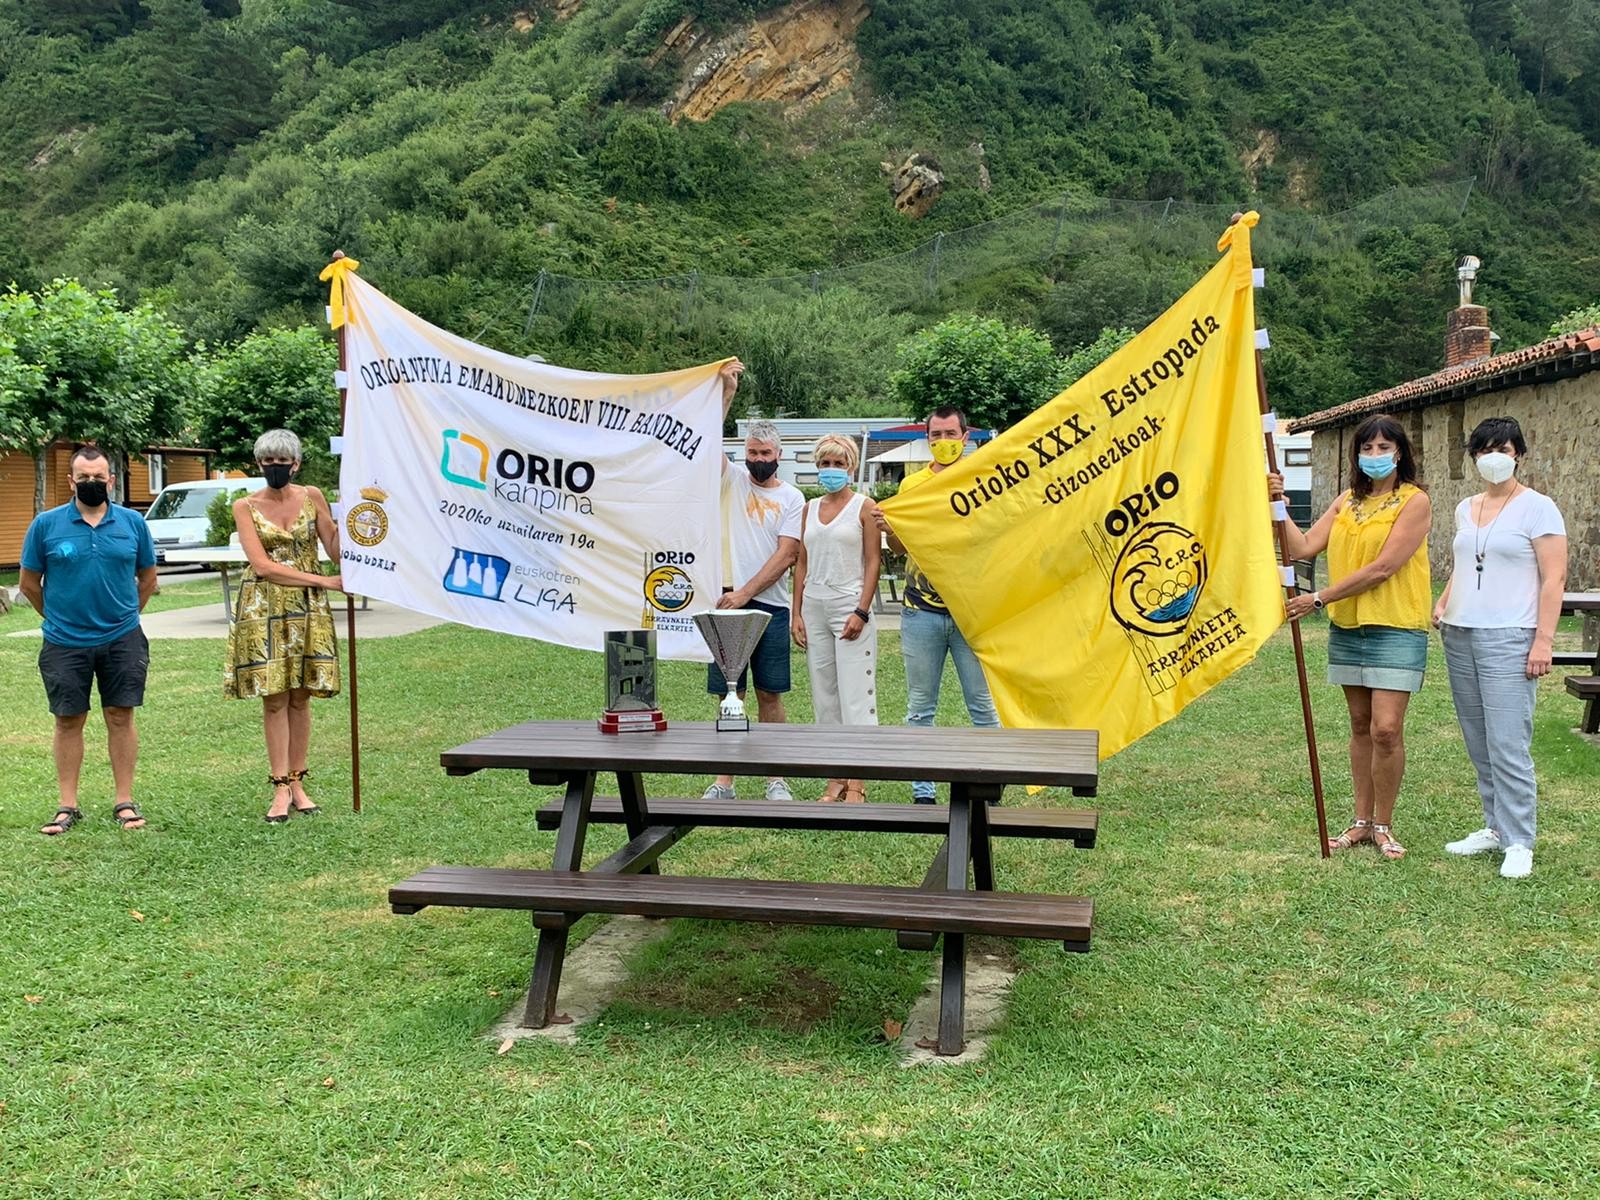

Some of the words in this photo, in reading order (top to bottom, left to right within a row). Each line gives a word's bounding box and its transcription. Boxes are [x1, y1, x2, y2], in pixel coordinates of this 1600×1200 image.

[457, 364, 593, 425] EMAKUMEZKOEN
[629, 412, 703, 461] BANDERA
[950, 459, 1030, 517] Orioko
[1027, 413, 1096, 468] XXX.
[1100, 316, 1220, 418] Estropada
[496, 448, 595, 493] ORIO
[494, 478, 595, 515] kanpina
[439, 500, 492, 526] 2020ko
[569, 533, 596, 549] 19a
[514, 563, 581, 586] euskotren
[513, 583, 578, 615] LIGA
[1179, 623, 1247, 678] ELKARTEA
